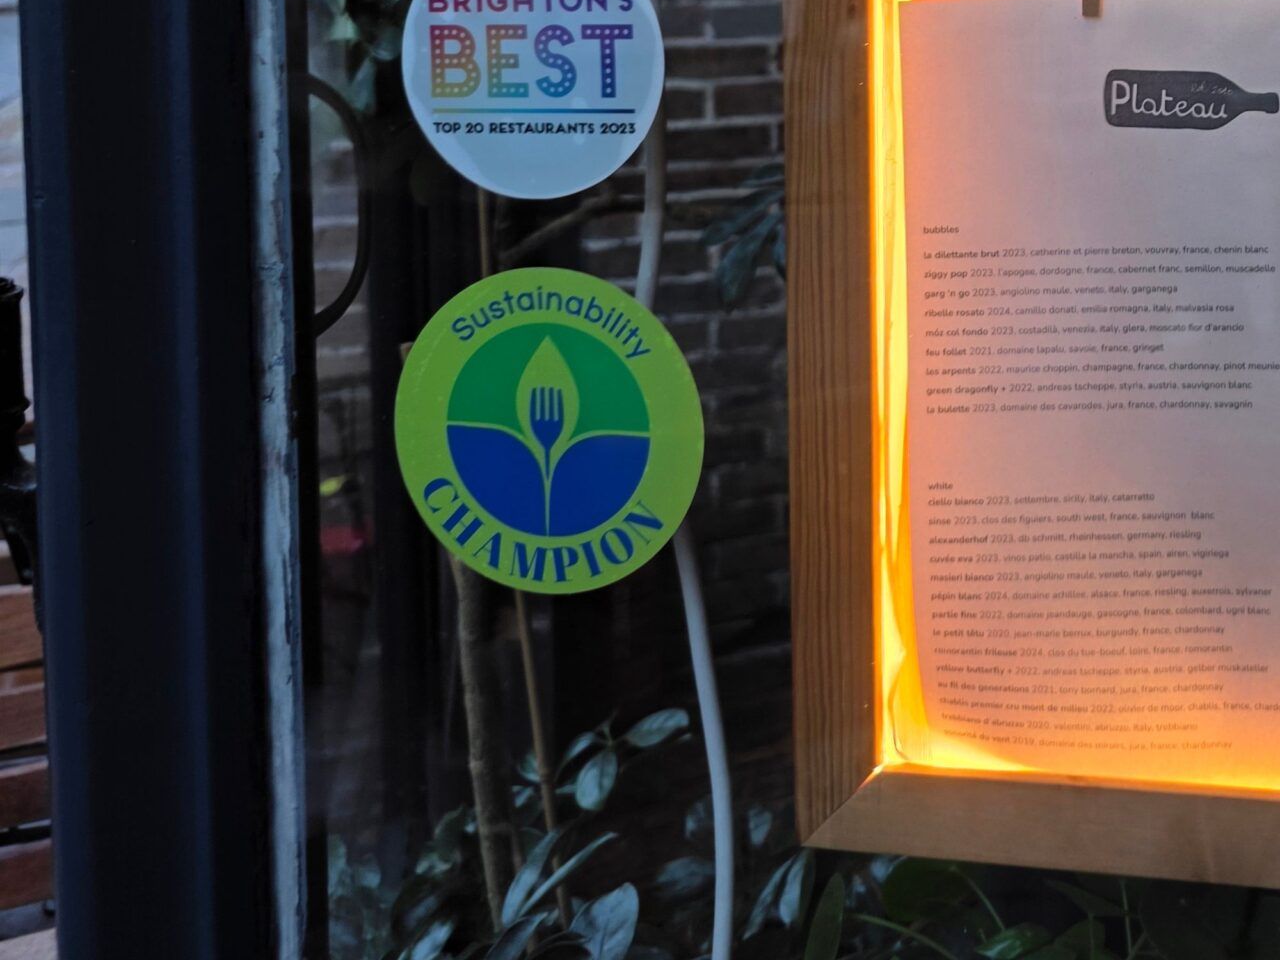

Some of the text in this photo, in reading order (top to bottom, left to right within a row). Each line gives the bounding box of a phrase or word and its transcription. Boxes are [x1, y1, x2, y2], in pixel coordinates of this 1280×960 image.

[430, 24, 633, 98] BEST
[1111, 80, 1228, 119] Plateau
[433, 122, 636, 134] TOP 20 RESTAURANTS 2023
[923, 225, 959, 233] bubbles
[451, 285, 651, 360] Sustainability
[422, 476, 664, 582] CHAMPION
